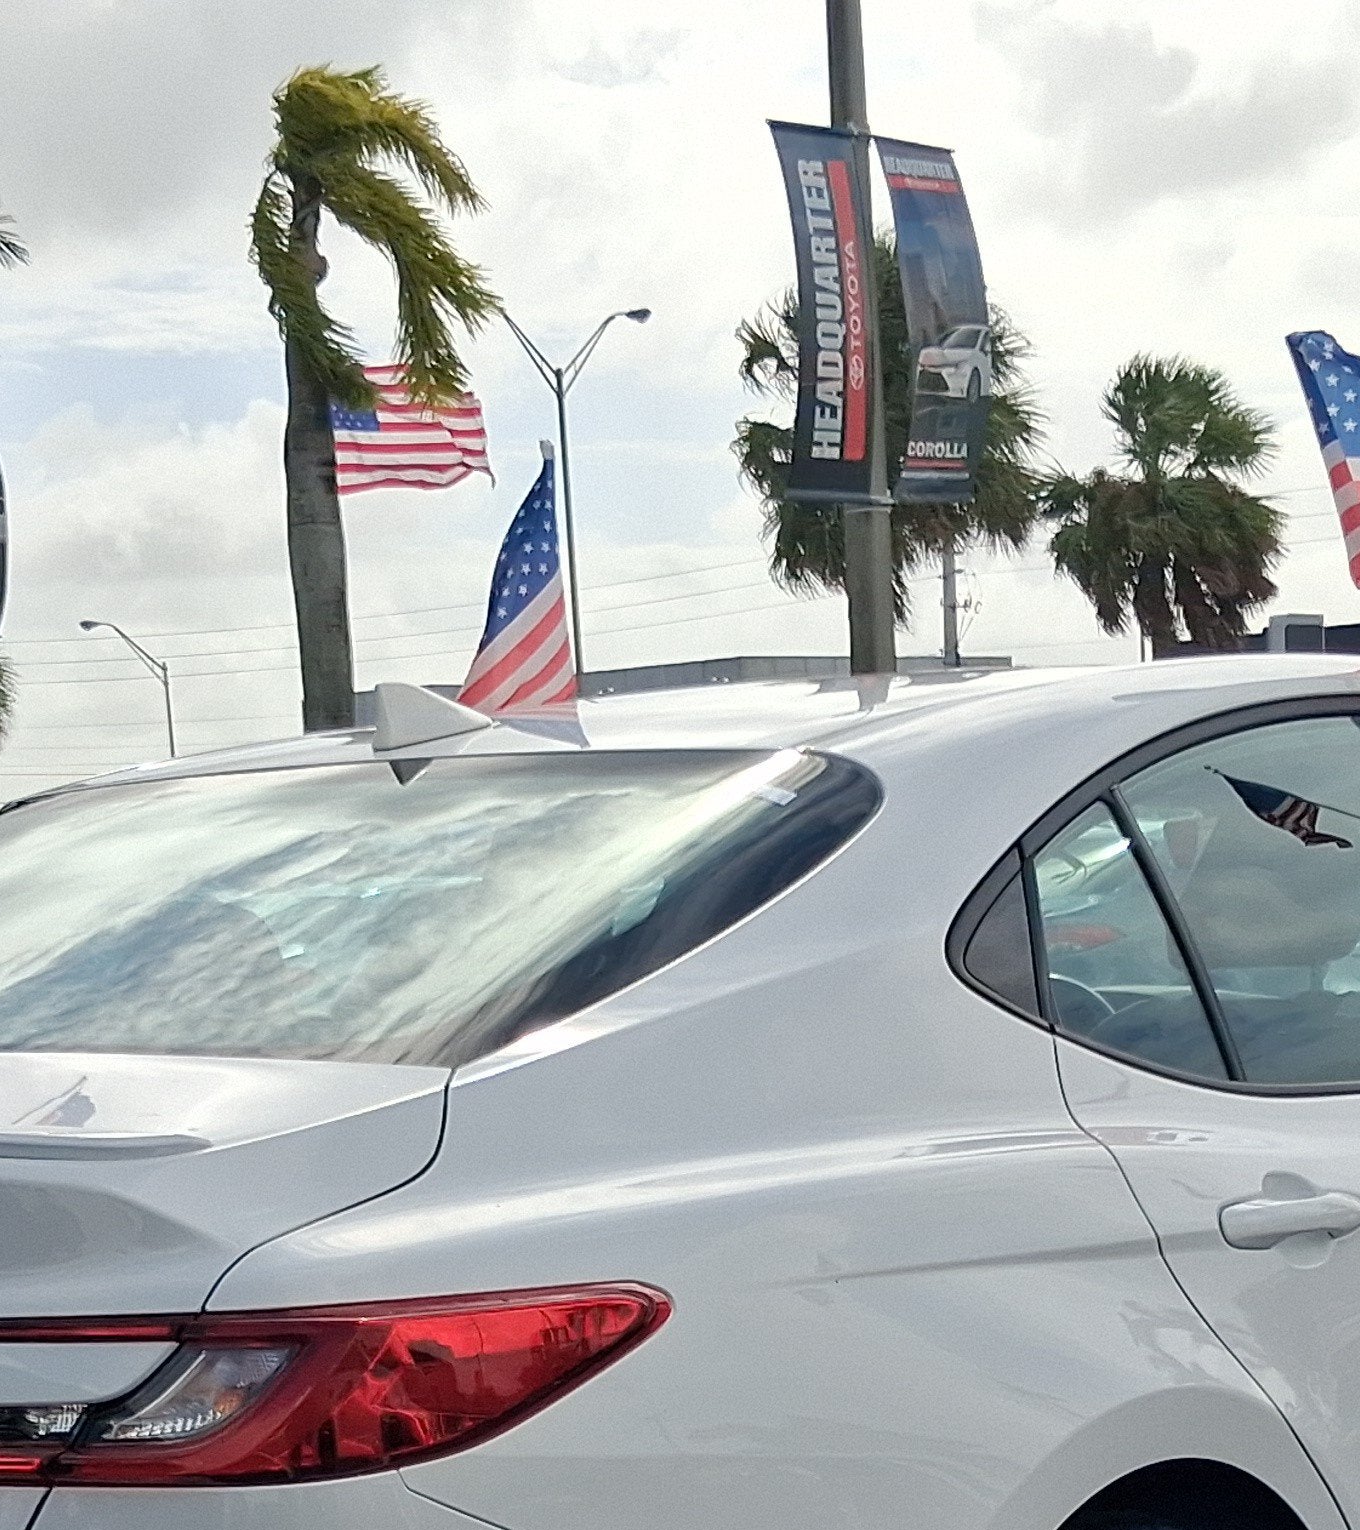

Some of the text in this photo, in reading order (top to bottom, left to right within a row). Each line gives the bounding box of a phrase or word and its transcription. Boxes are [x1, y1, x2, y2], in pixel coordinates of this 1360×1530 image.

[798, 159, 846, 460] HEADQUARTER
[844, 241, 863, 350] TOYOTA
[907, 440, 968, 459] COROLLA
